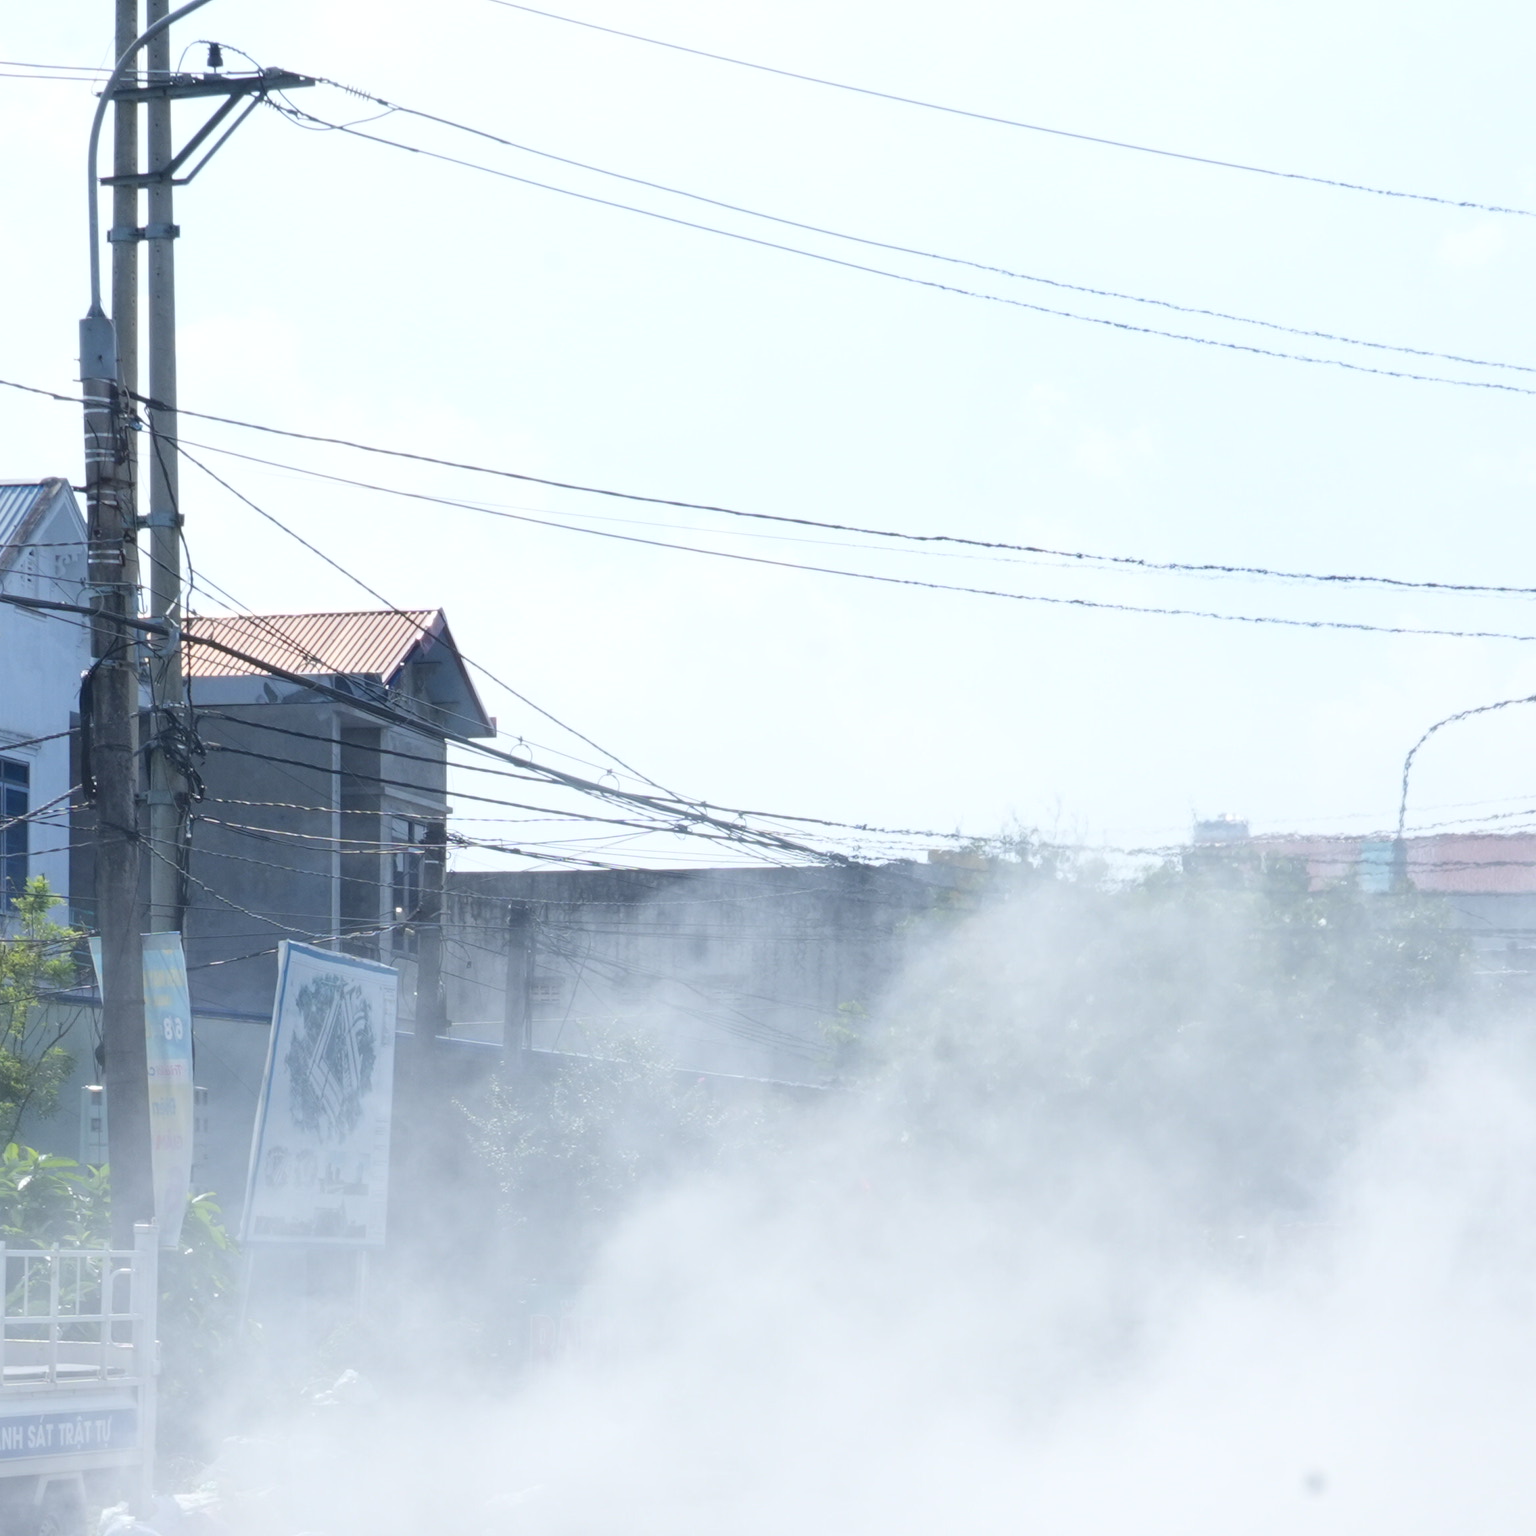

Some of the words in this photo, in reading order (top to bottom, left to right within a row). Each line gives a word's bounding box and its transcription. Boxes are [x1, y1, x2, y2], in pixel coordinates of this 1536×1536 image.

[27, 1414, 56, 1449] SÁT
[58, 1416, 94, 1450] TRẬT
[95, 1414, 114, 1448] TỰ
